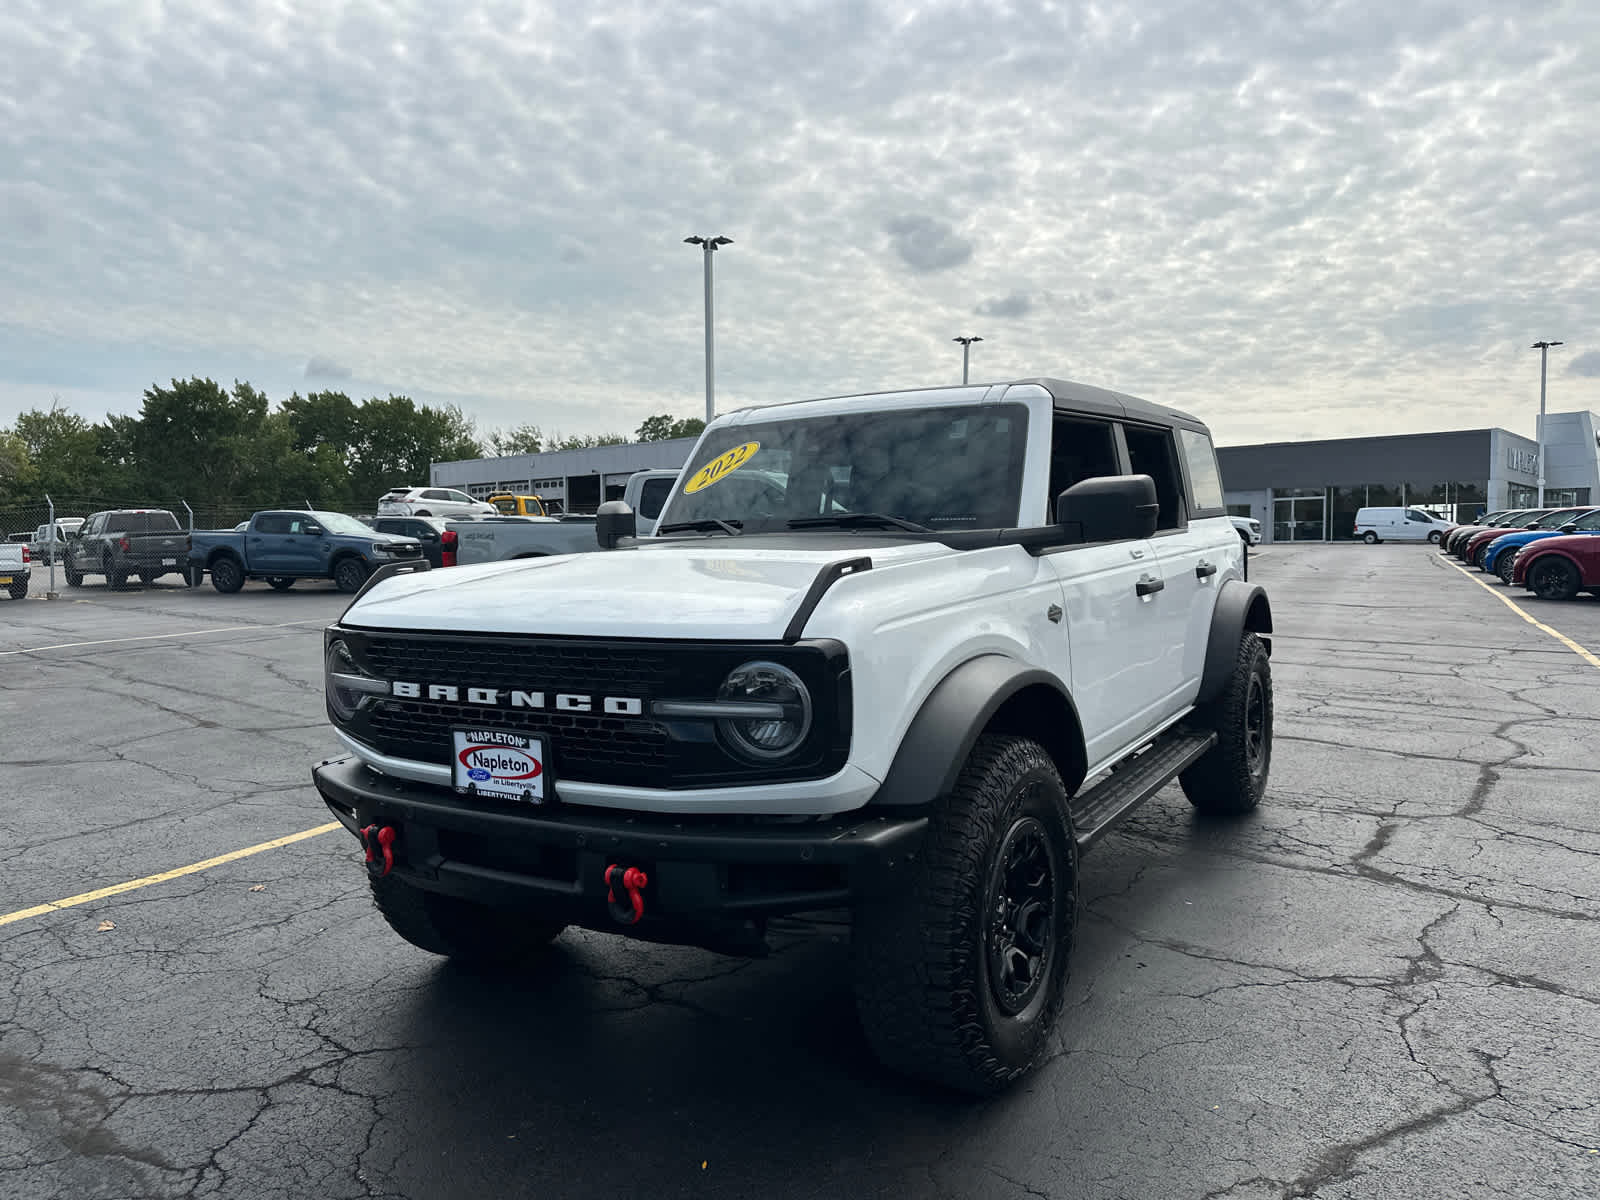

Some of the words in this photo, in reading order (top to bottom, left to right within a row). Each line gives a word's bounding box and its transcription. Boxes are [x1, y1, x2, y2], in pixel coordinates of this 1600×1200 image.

[697, 446, 747, 488] 2022
[392, 681, 642, 715] BRONCO
[470, 731, 522, 747] NAPLETON
[473, 752, 529, 772] Napleton
[501, 779, 536, 790] Libertyville
[476, 789, 520, 800] LIBERTYVILLE
